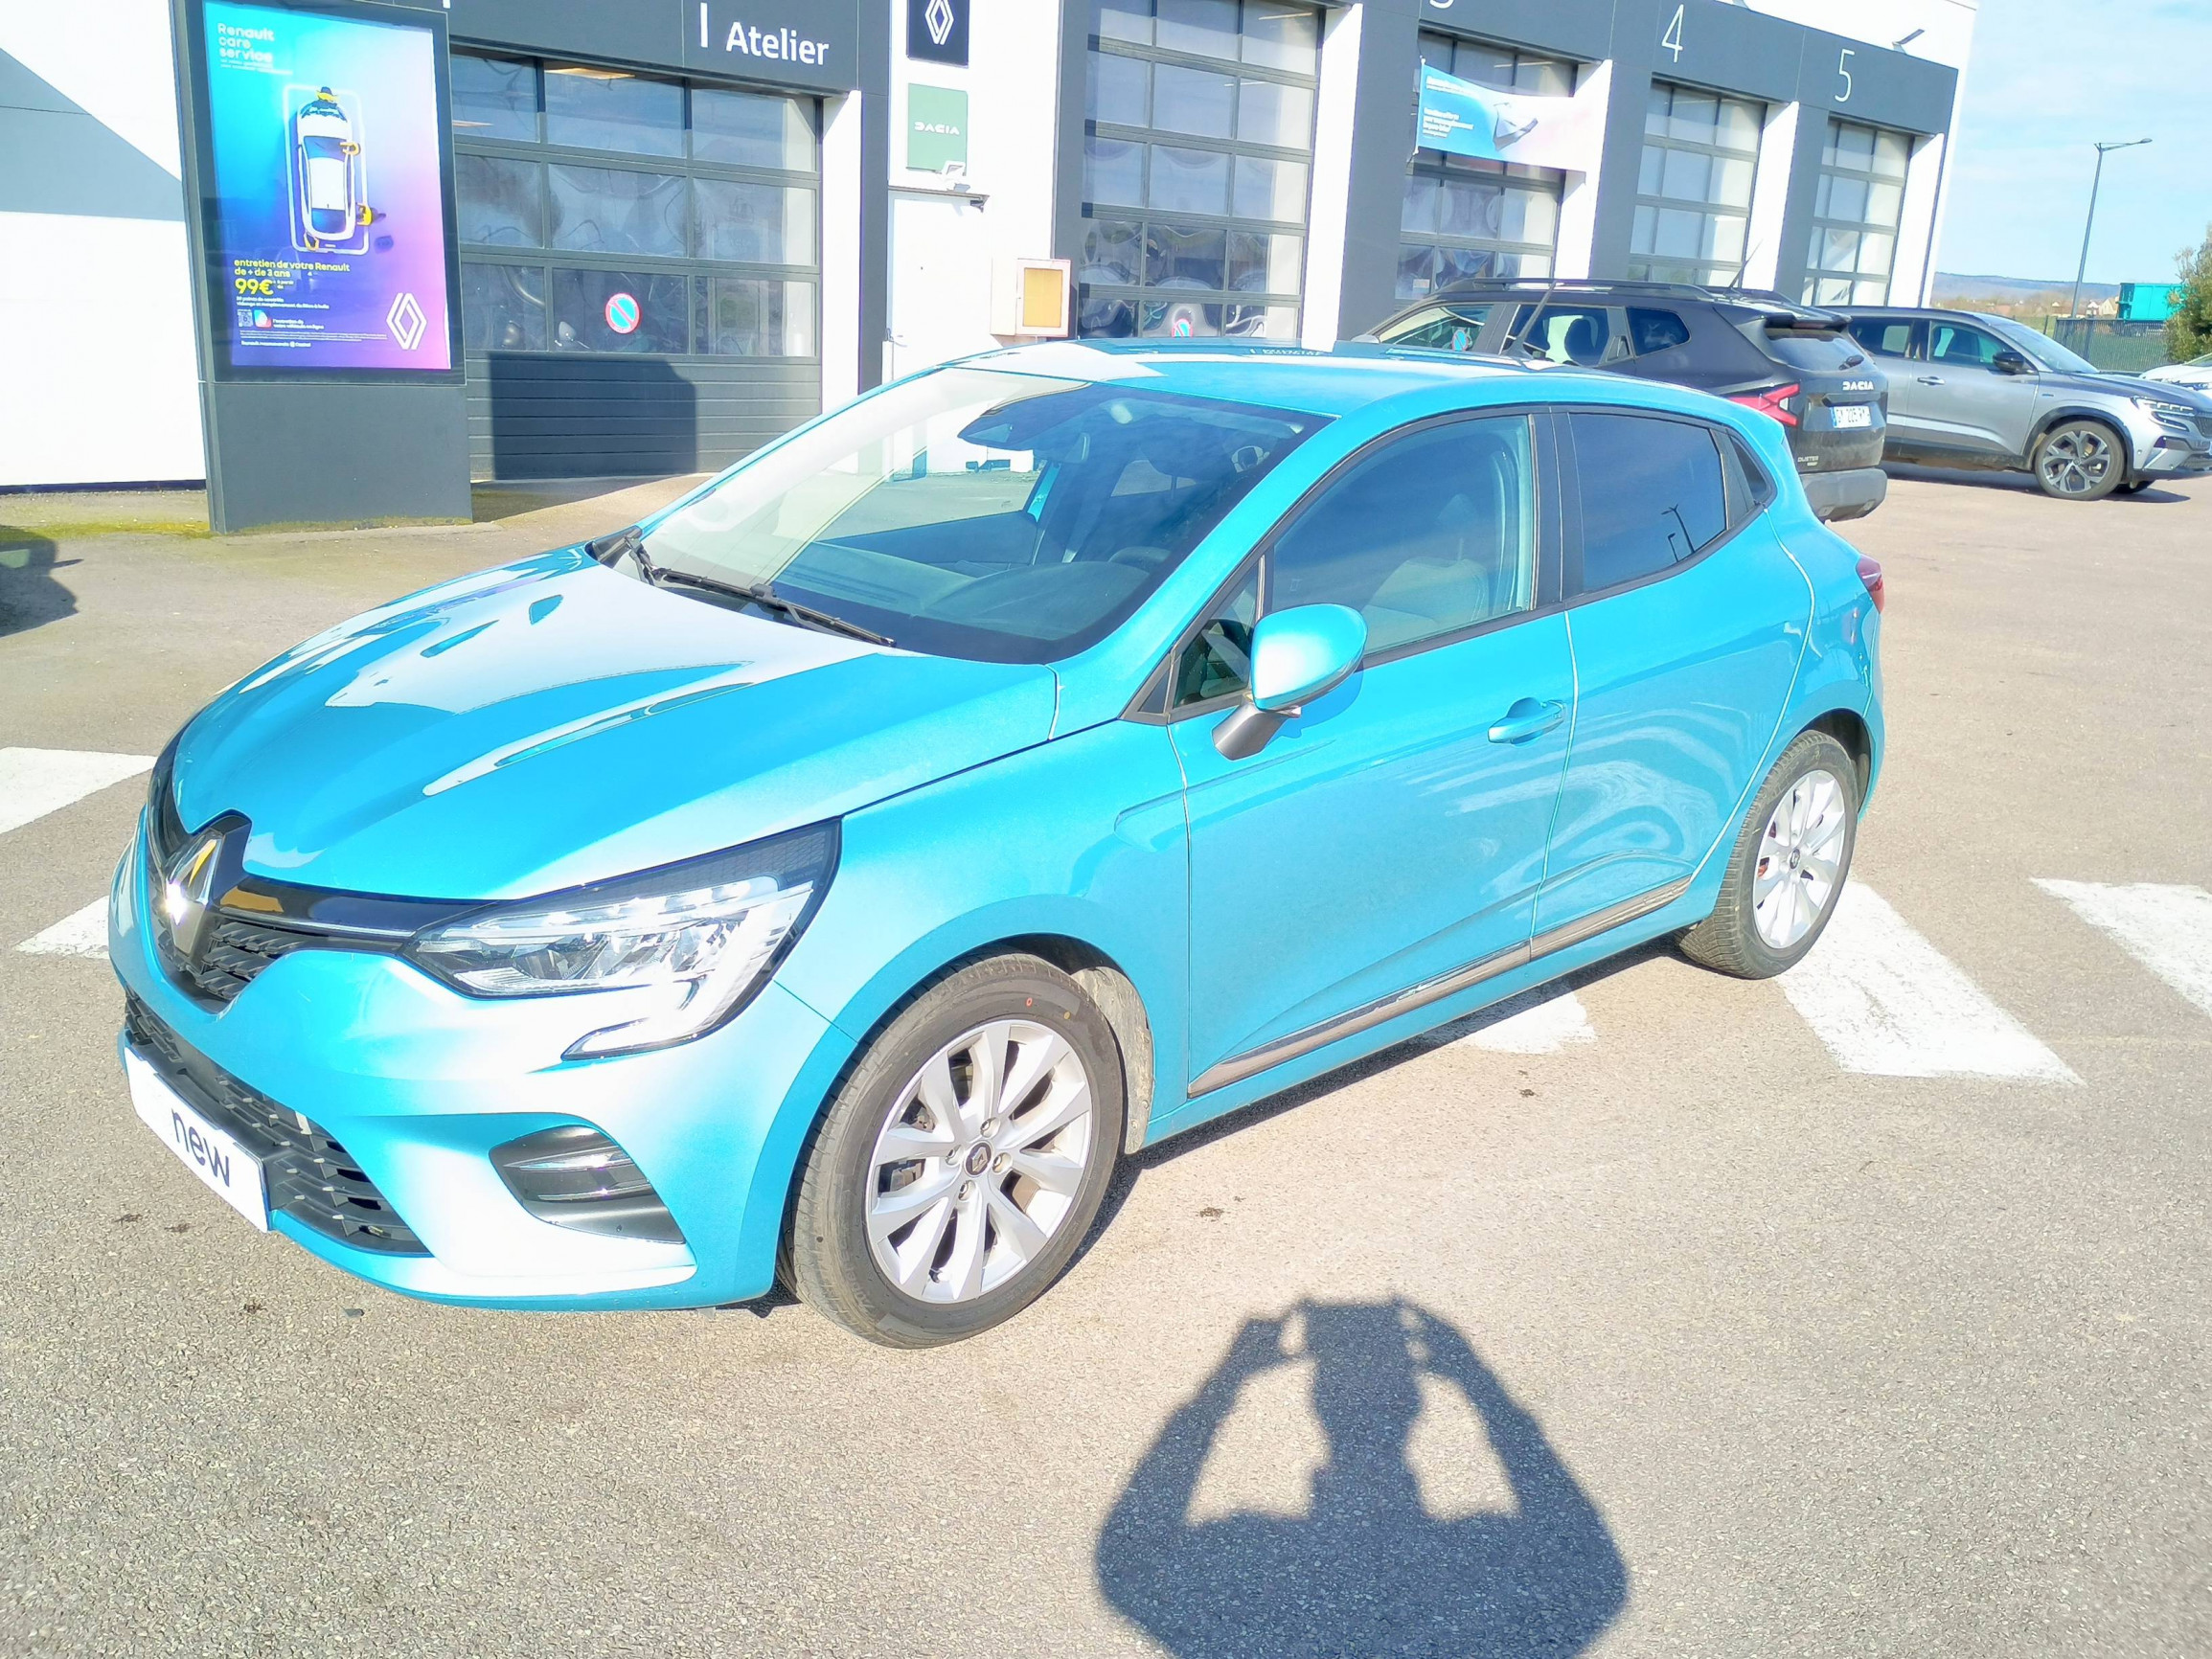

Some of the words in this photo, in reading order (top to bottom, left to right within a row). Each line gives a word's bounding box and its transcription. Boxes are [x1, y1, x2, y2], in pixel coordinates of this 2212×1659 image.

[217, 22, 275, 42] Renault
[1661, 4, 1684, 63] 4
[218, 36, 252, 50] care
[726, 21, 830, 65] Atelier
[219, 48, 274, 63] service
[1835, 48, 1856, 102] 5
[914, 121, 960, 136] DACIA
[234, 259, 276, 268] entretien
[289, 261, 314, 270] votre
[314, 261, 351, 272] Renault
[234, 267, 247, 276] de
[254, 267, 266, 277] de
[235, 278, 274, 296] 99€
[1841, 380, 1875, 391] DACIA
[171, 1107, 230, 1188] new
